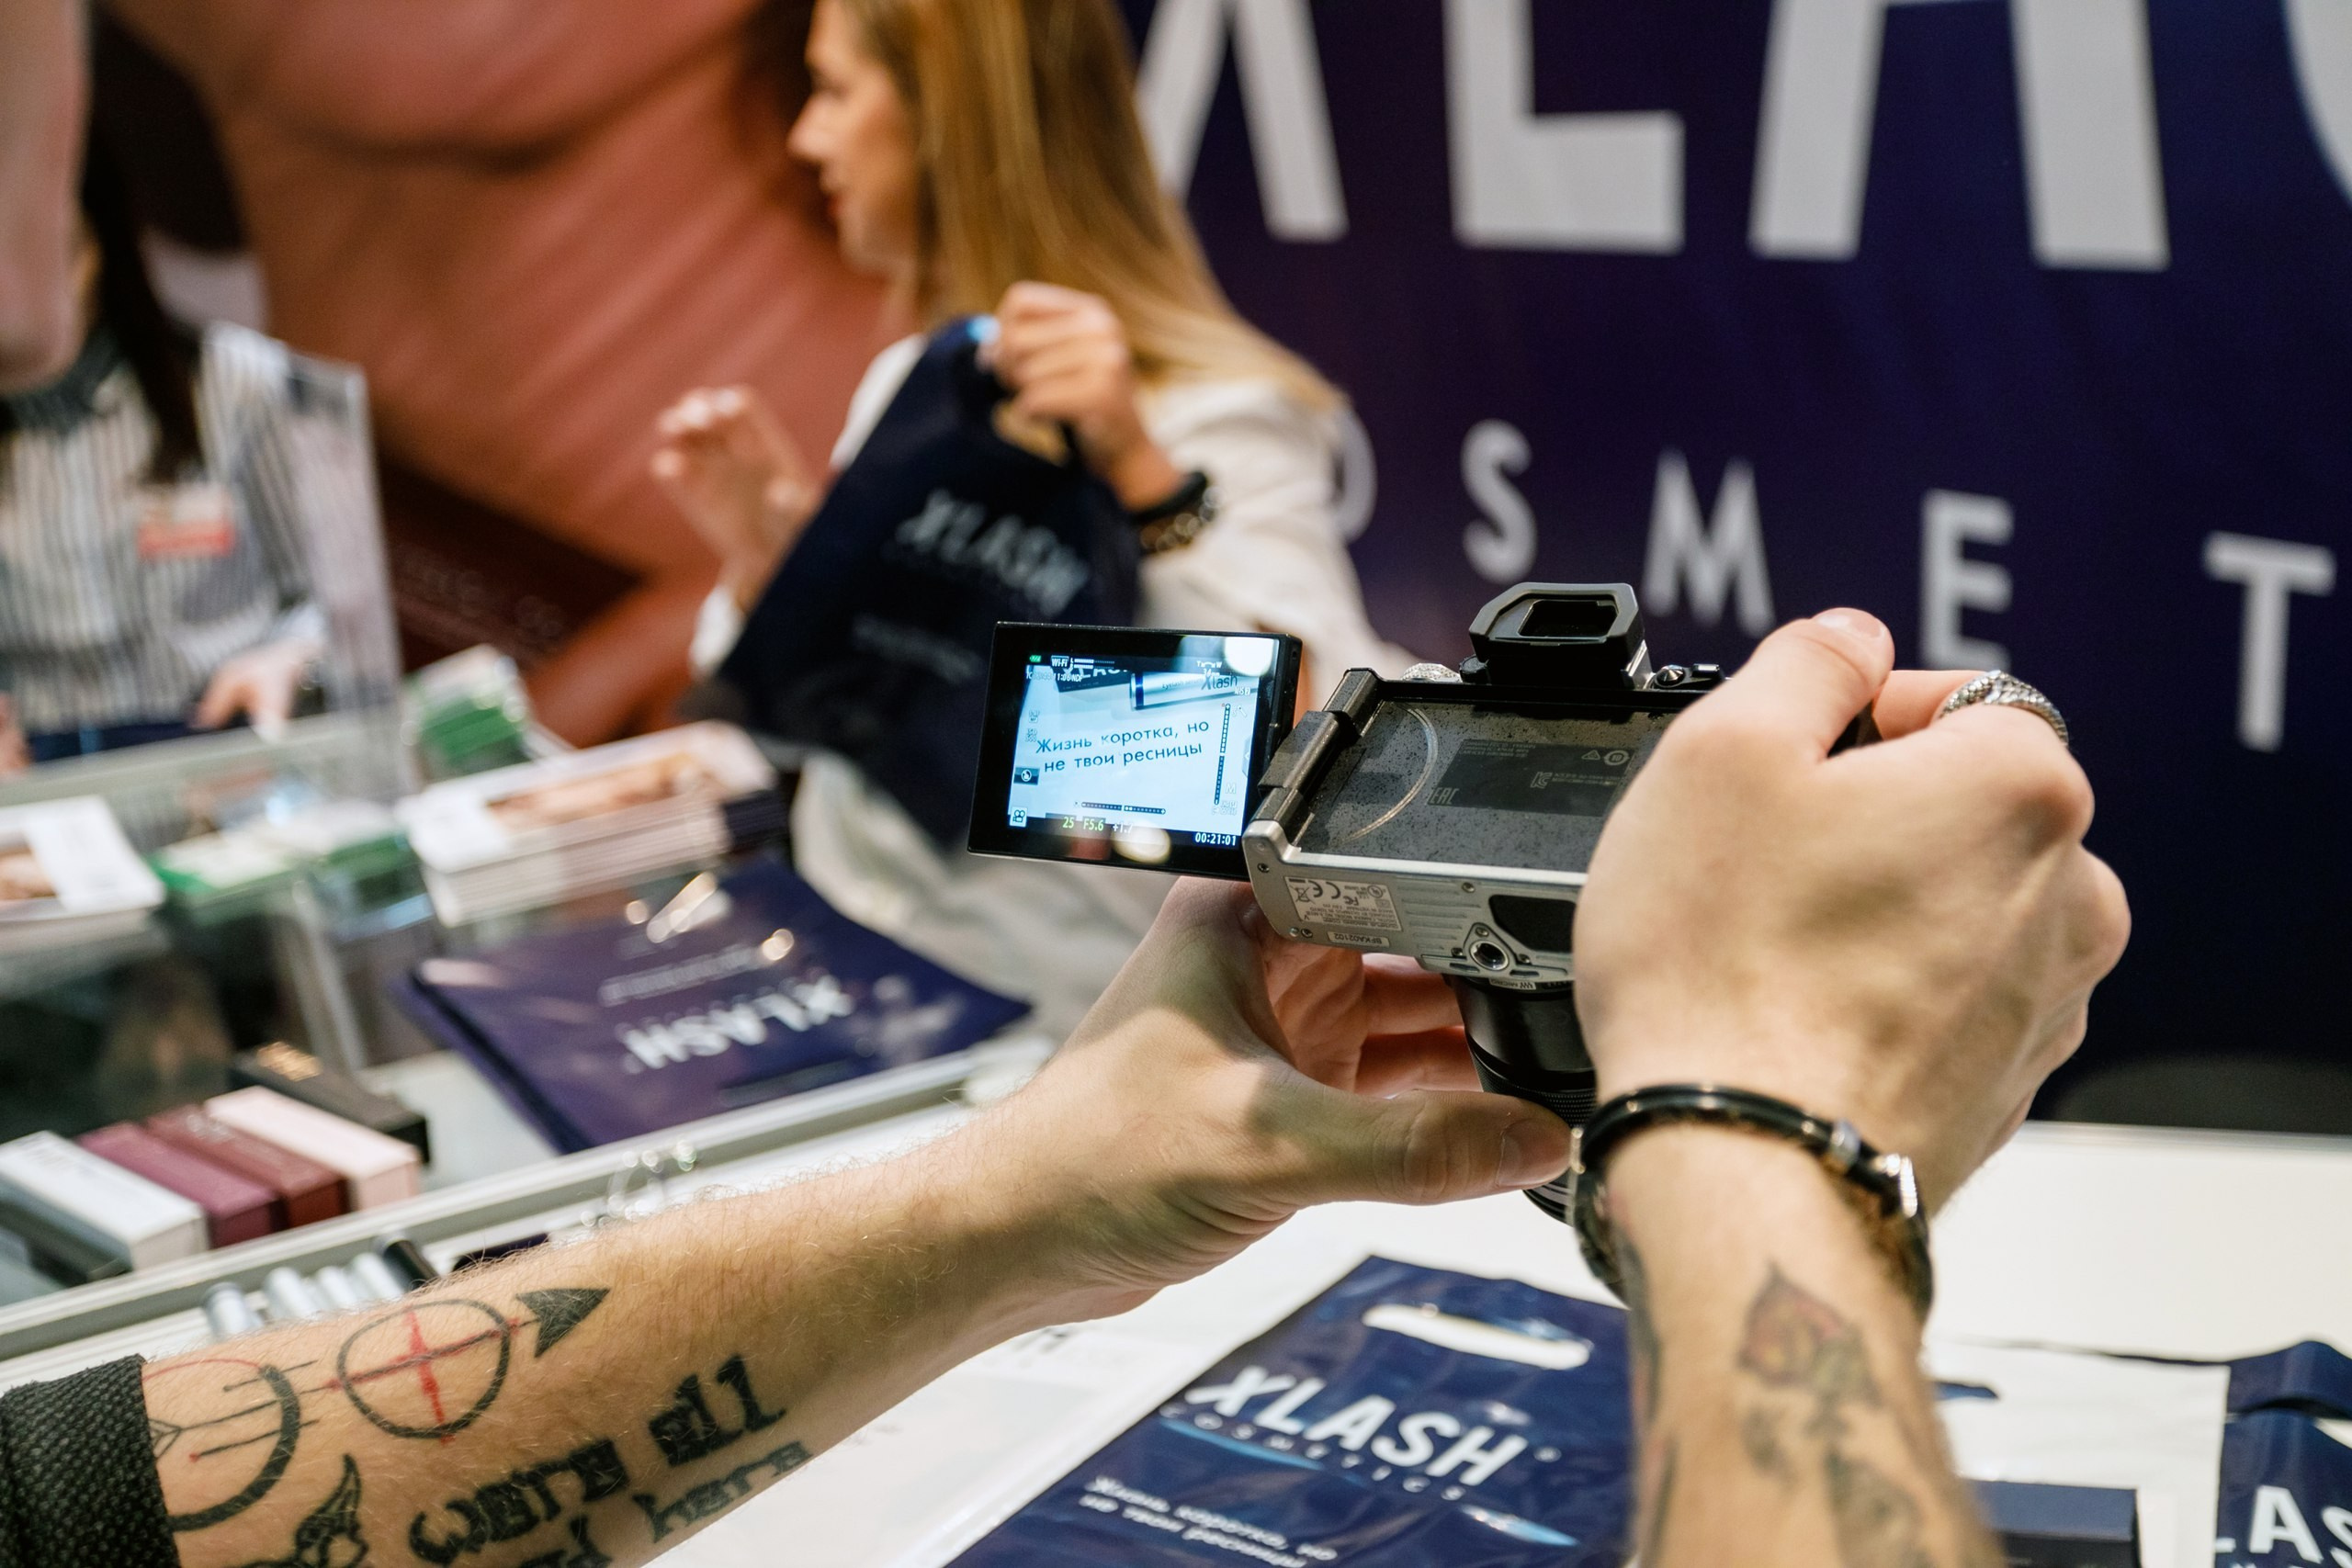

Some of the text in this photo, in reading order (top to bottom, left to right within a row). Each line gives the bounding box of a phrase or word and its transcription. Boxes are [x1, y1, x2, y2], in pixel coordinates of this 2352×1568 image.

[1201, 671, 1238, 690] Xlash
[1035, 738, 1092, 753] Жизнь
[1102, 727, 1179, 746] коротка,
[1187, 721, 1209, 734] но
[1045, 743, 1202, 773] не твои ресницы
[1062, 816, 1075, 829] 25
[1082, 818, 1104, 831] F5.6
[1194, 832, 1237, 846] 00:21:01
[1183, 1364, 1530, 1486] XLASH
